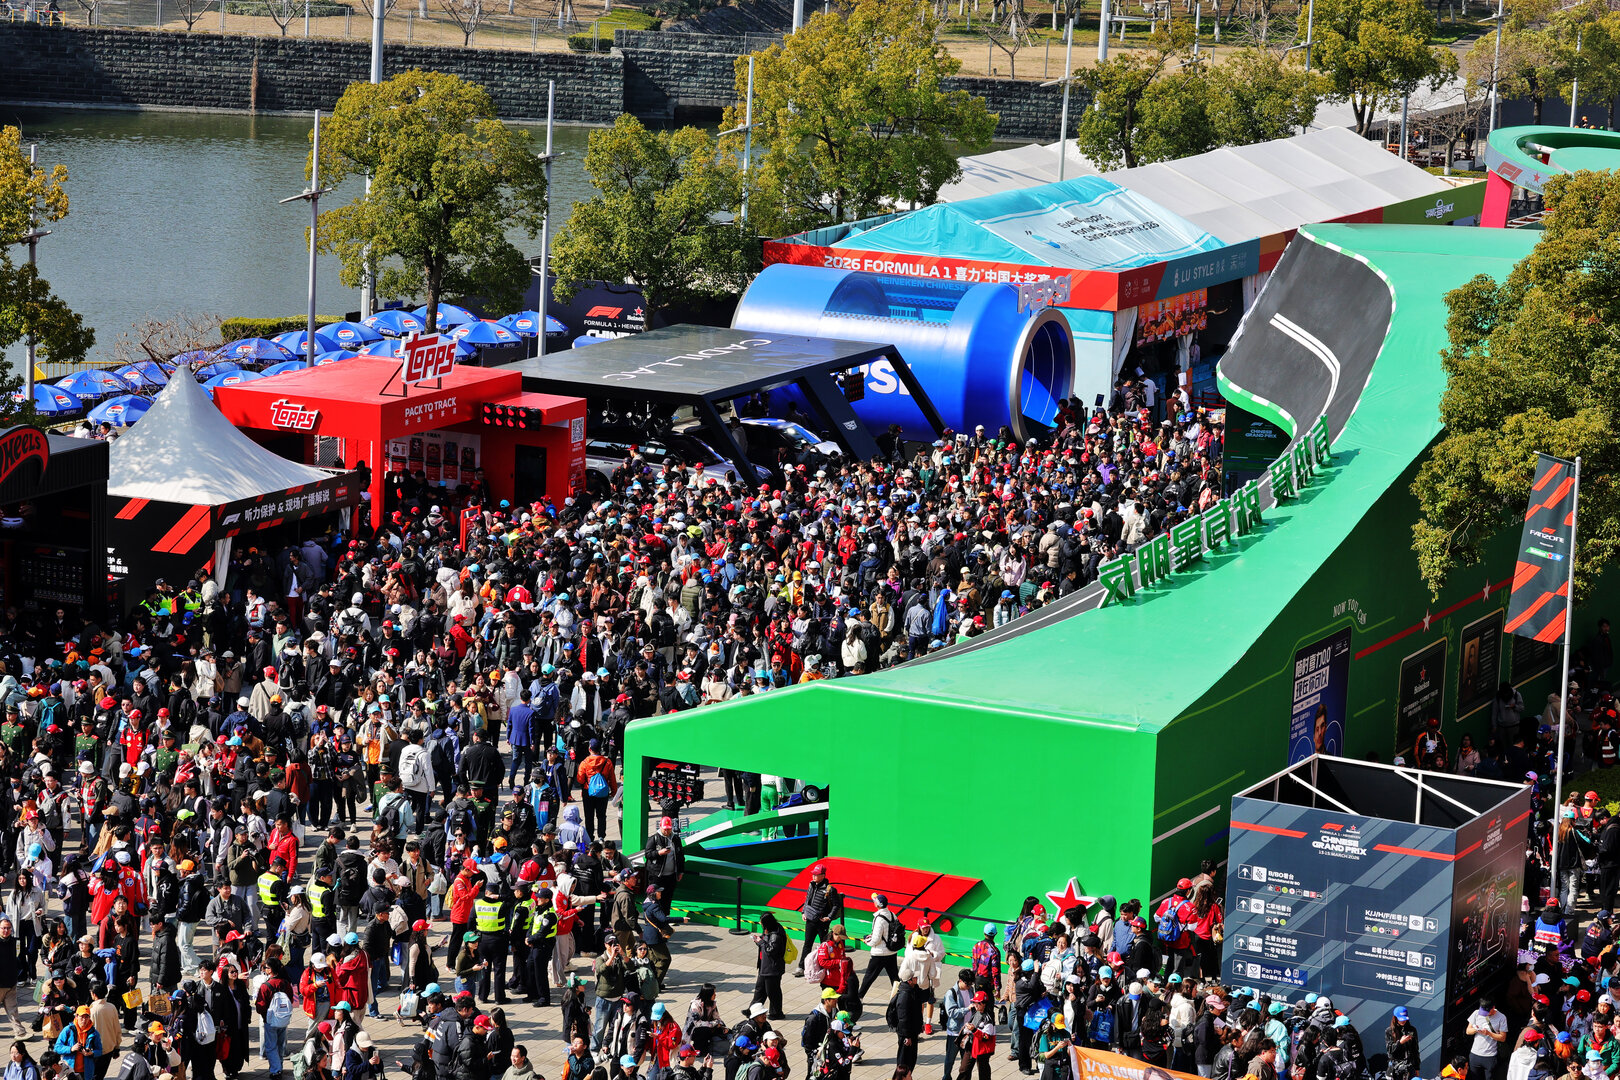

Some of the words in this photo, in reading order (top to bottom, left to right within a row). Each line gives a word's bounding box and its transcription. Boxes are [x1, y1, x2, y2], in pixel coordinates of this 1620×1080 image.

[824, 255, 860, 270] 2026
[864, 258, 940, 279] FORMULA
[943, 266, 951, 279] 1
[1181, 270, 1191, 283] LU
[1193, 263, 1215, 280] STYLE
[877, 276, 925, 289] HEINEKEN
[1017, 273, 1072, 314] PEPSI
[583, 319, 612, 328] FORMULA
[602, 337, 773, 382] CADILLAC
[405, 403, 423, 418] PACK
[424, 401, 434, 412] TO
[434, 396, 457, 411] TRACK
[244, 504, 276, 522] 听力保护
[277, 503, 284, 512] &
[285, 488, 331, 512] 现场广播解说
[1529, 529, 1565, 544] FANZONE
[1332, 601, 1347, 618] NOW
[1347, 598, 1359, 613] YOU
[1311, 840, 1345, 853] GRAND
[1344, 845, 1368, 856] PRIX
[1320, 835, 1359, 848] CHINESE
[1264, 934, 1298, 945] 主看台俱乐部
